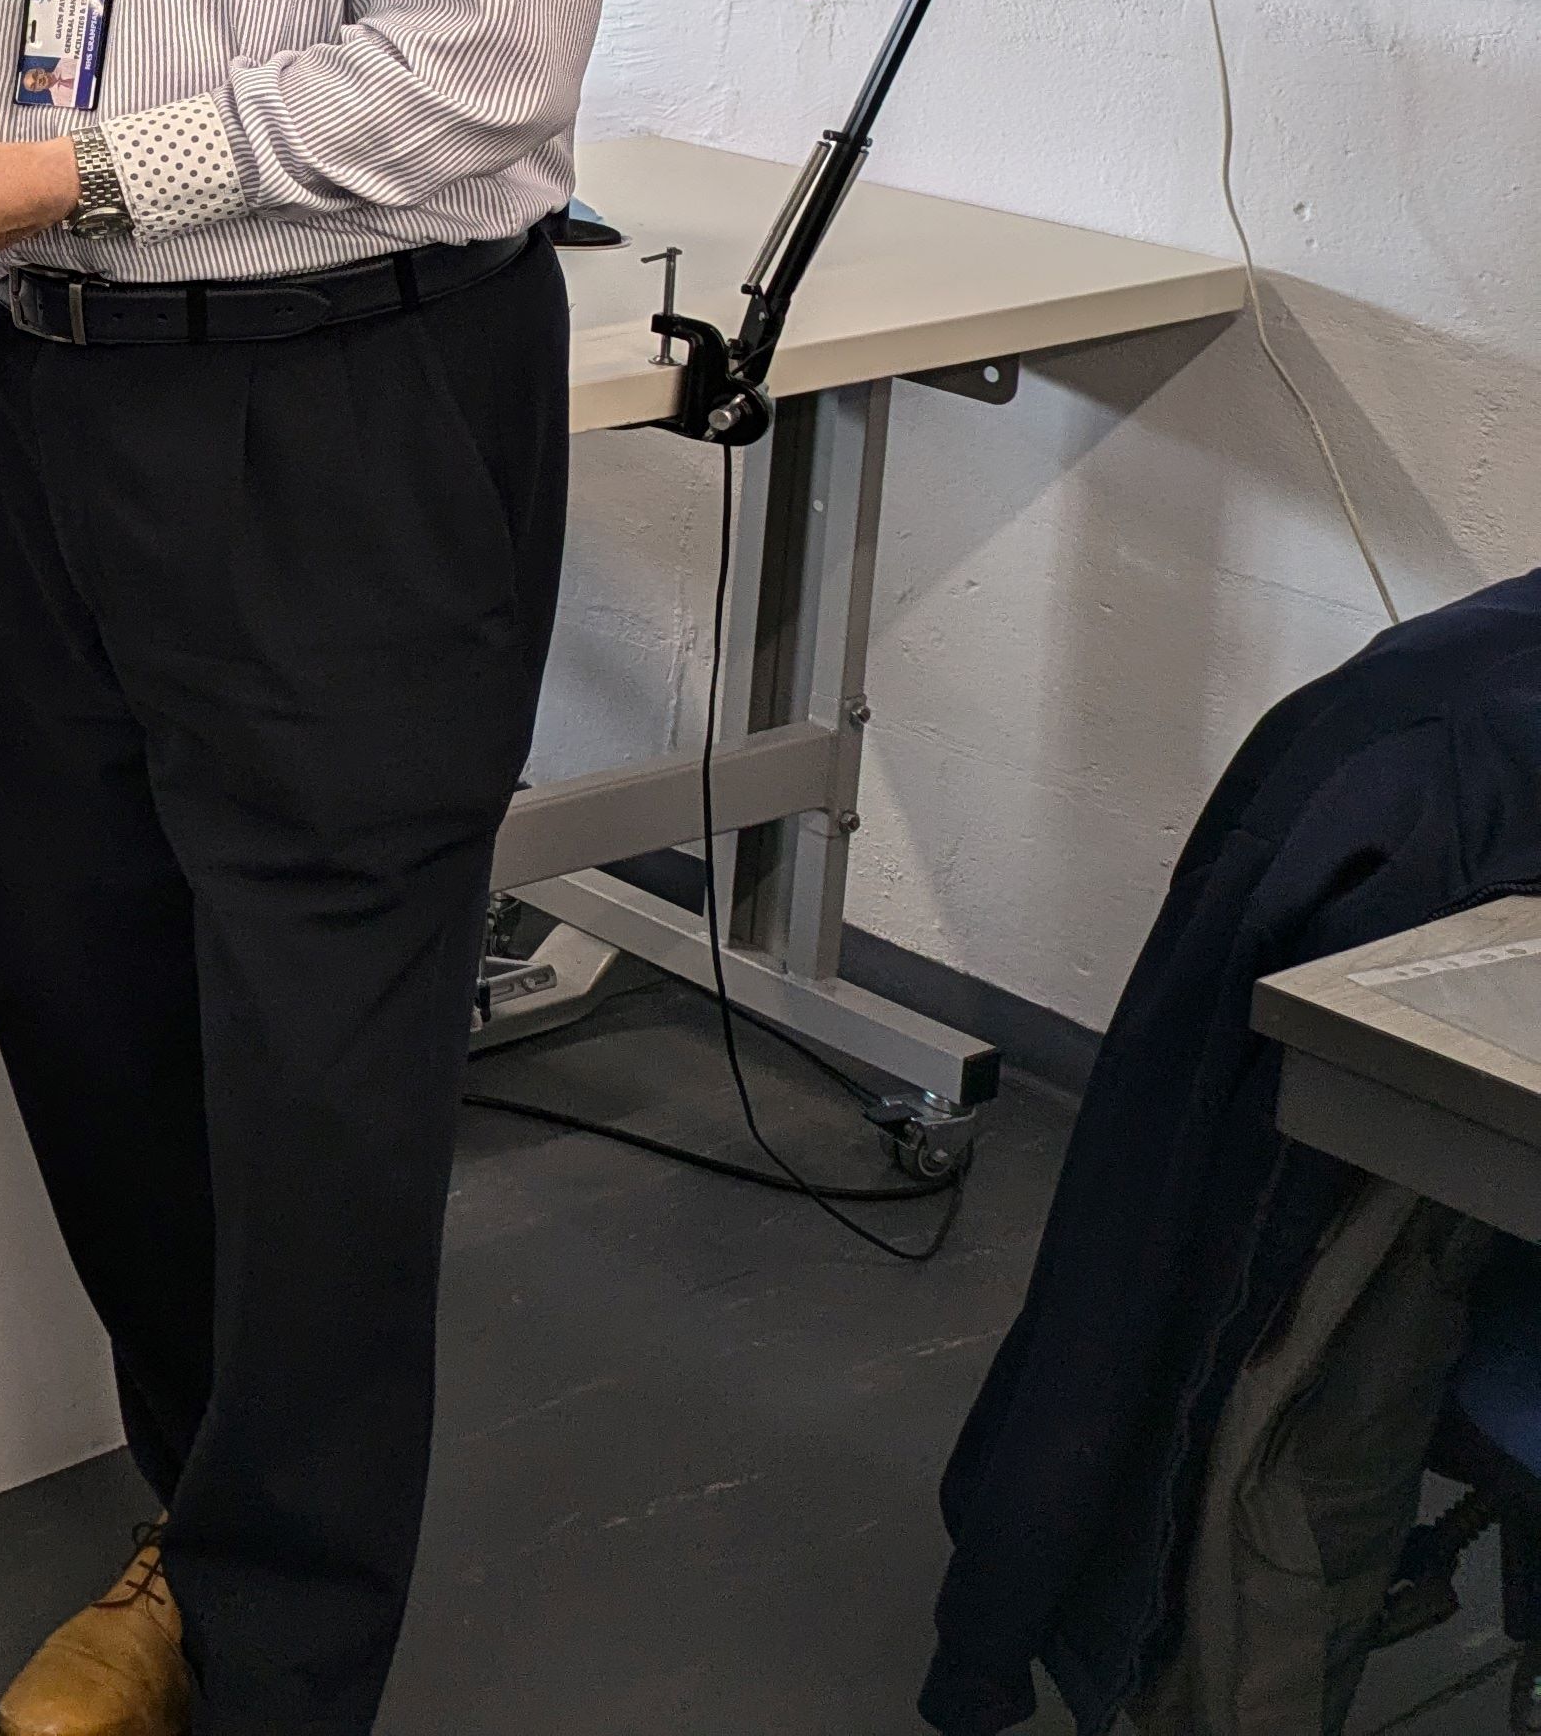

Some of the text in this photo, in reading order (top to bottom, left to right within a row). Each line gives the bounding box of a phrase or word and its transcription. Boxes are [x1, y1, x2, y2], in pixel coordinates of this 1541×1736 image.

[55, 16, 64, 40] GAVIN
[64, 17, 75, 55] GENERAL
[74, 15, 85, 60] FACILITIES
[85, 53, 93, 70] NHS
